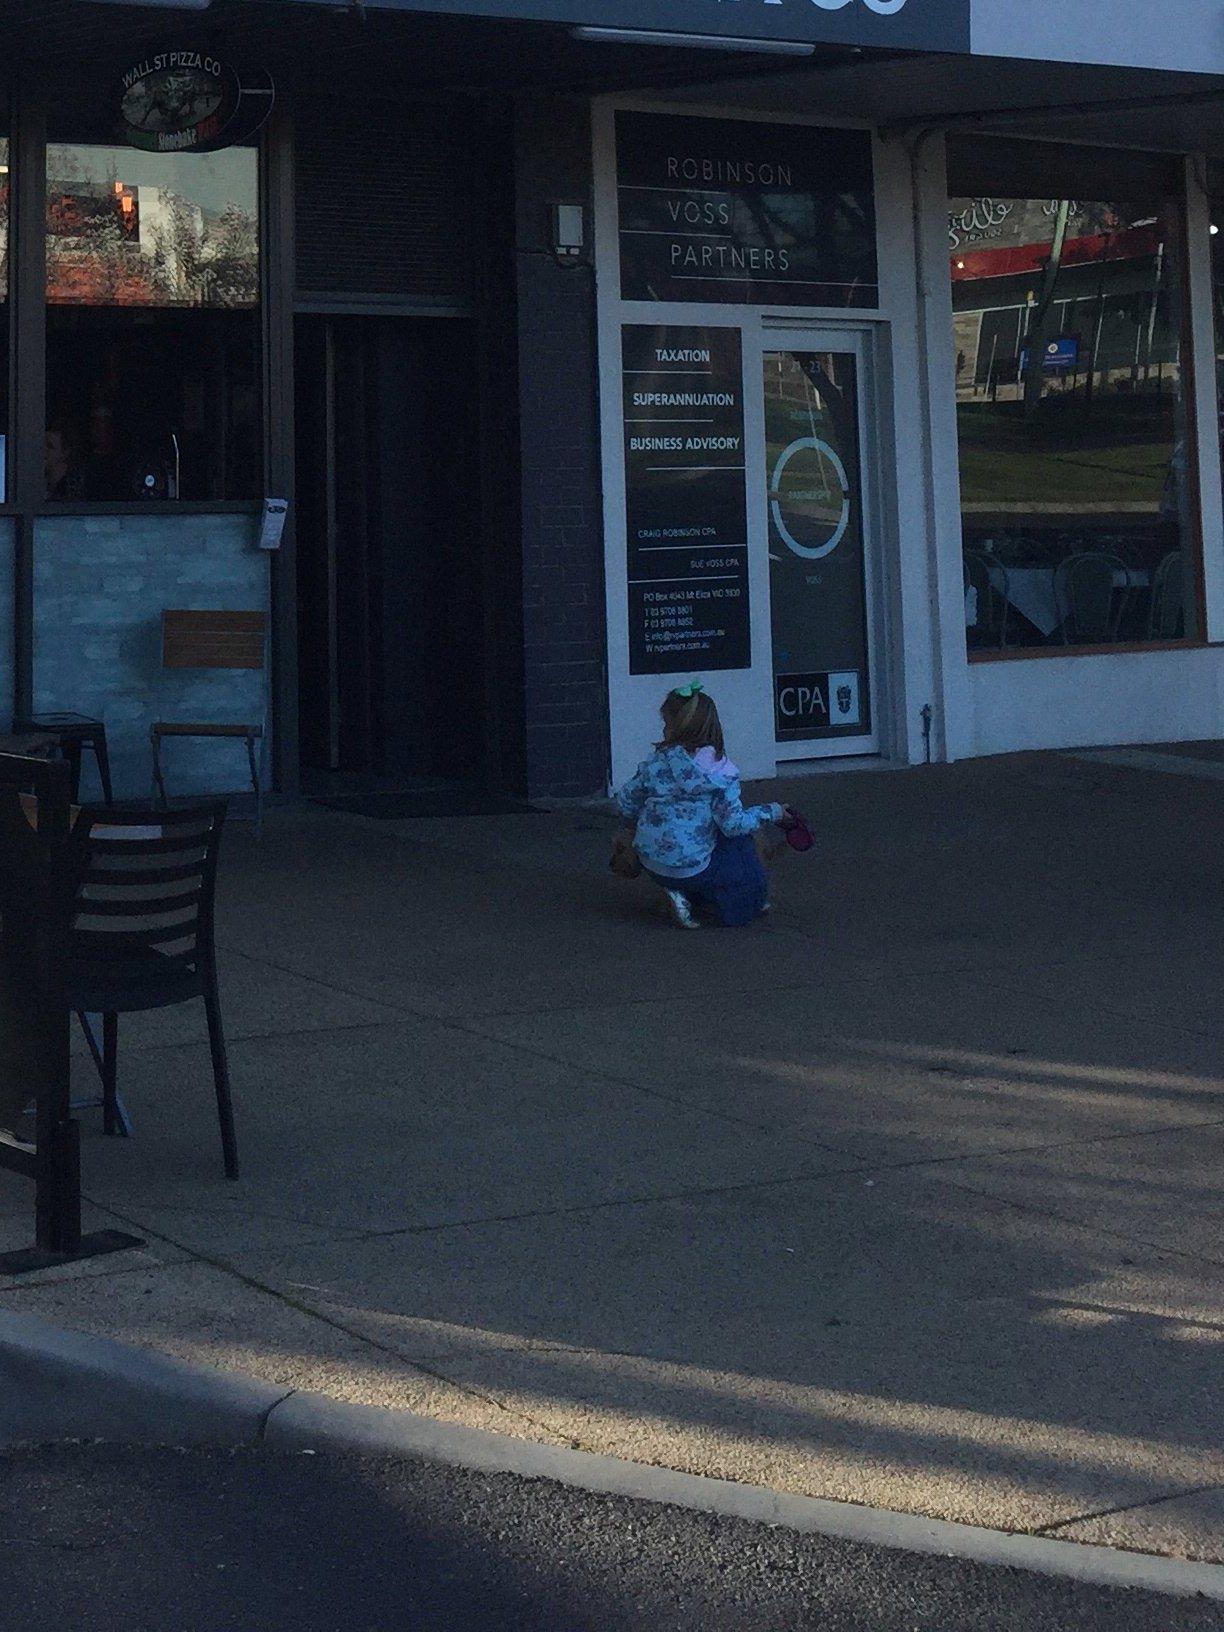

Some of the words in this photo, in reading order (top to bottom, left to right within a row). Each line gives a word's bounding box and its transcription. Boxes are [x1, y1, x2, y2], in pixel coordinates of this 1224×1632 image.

[122, 59, 154, 89] WALL
[153, 53, 169, 70] ST
[170, 51, 202, 68] PIZZA
[204, 57, 221, 77] CO
[667, 156, 792, 186] ROBINSON
[668, 200, 729, 225] VOSS
[671, 244, 790, 271] PARTNERS
[655, 349, 710, 363] TAXATION
[633, 392, 735, 406] SUPERANNUATION
[629, 437, 683, 450] BUSINESS
[685, 436, 741, 450] ADVISORY
[637, 528, 661, 539] CRAIG
[779, 686, 827, 716] CPA
